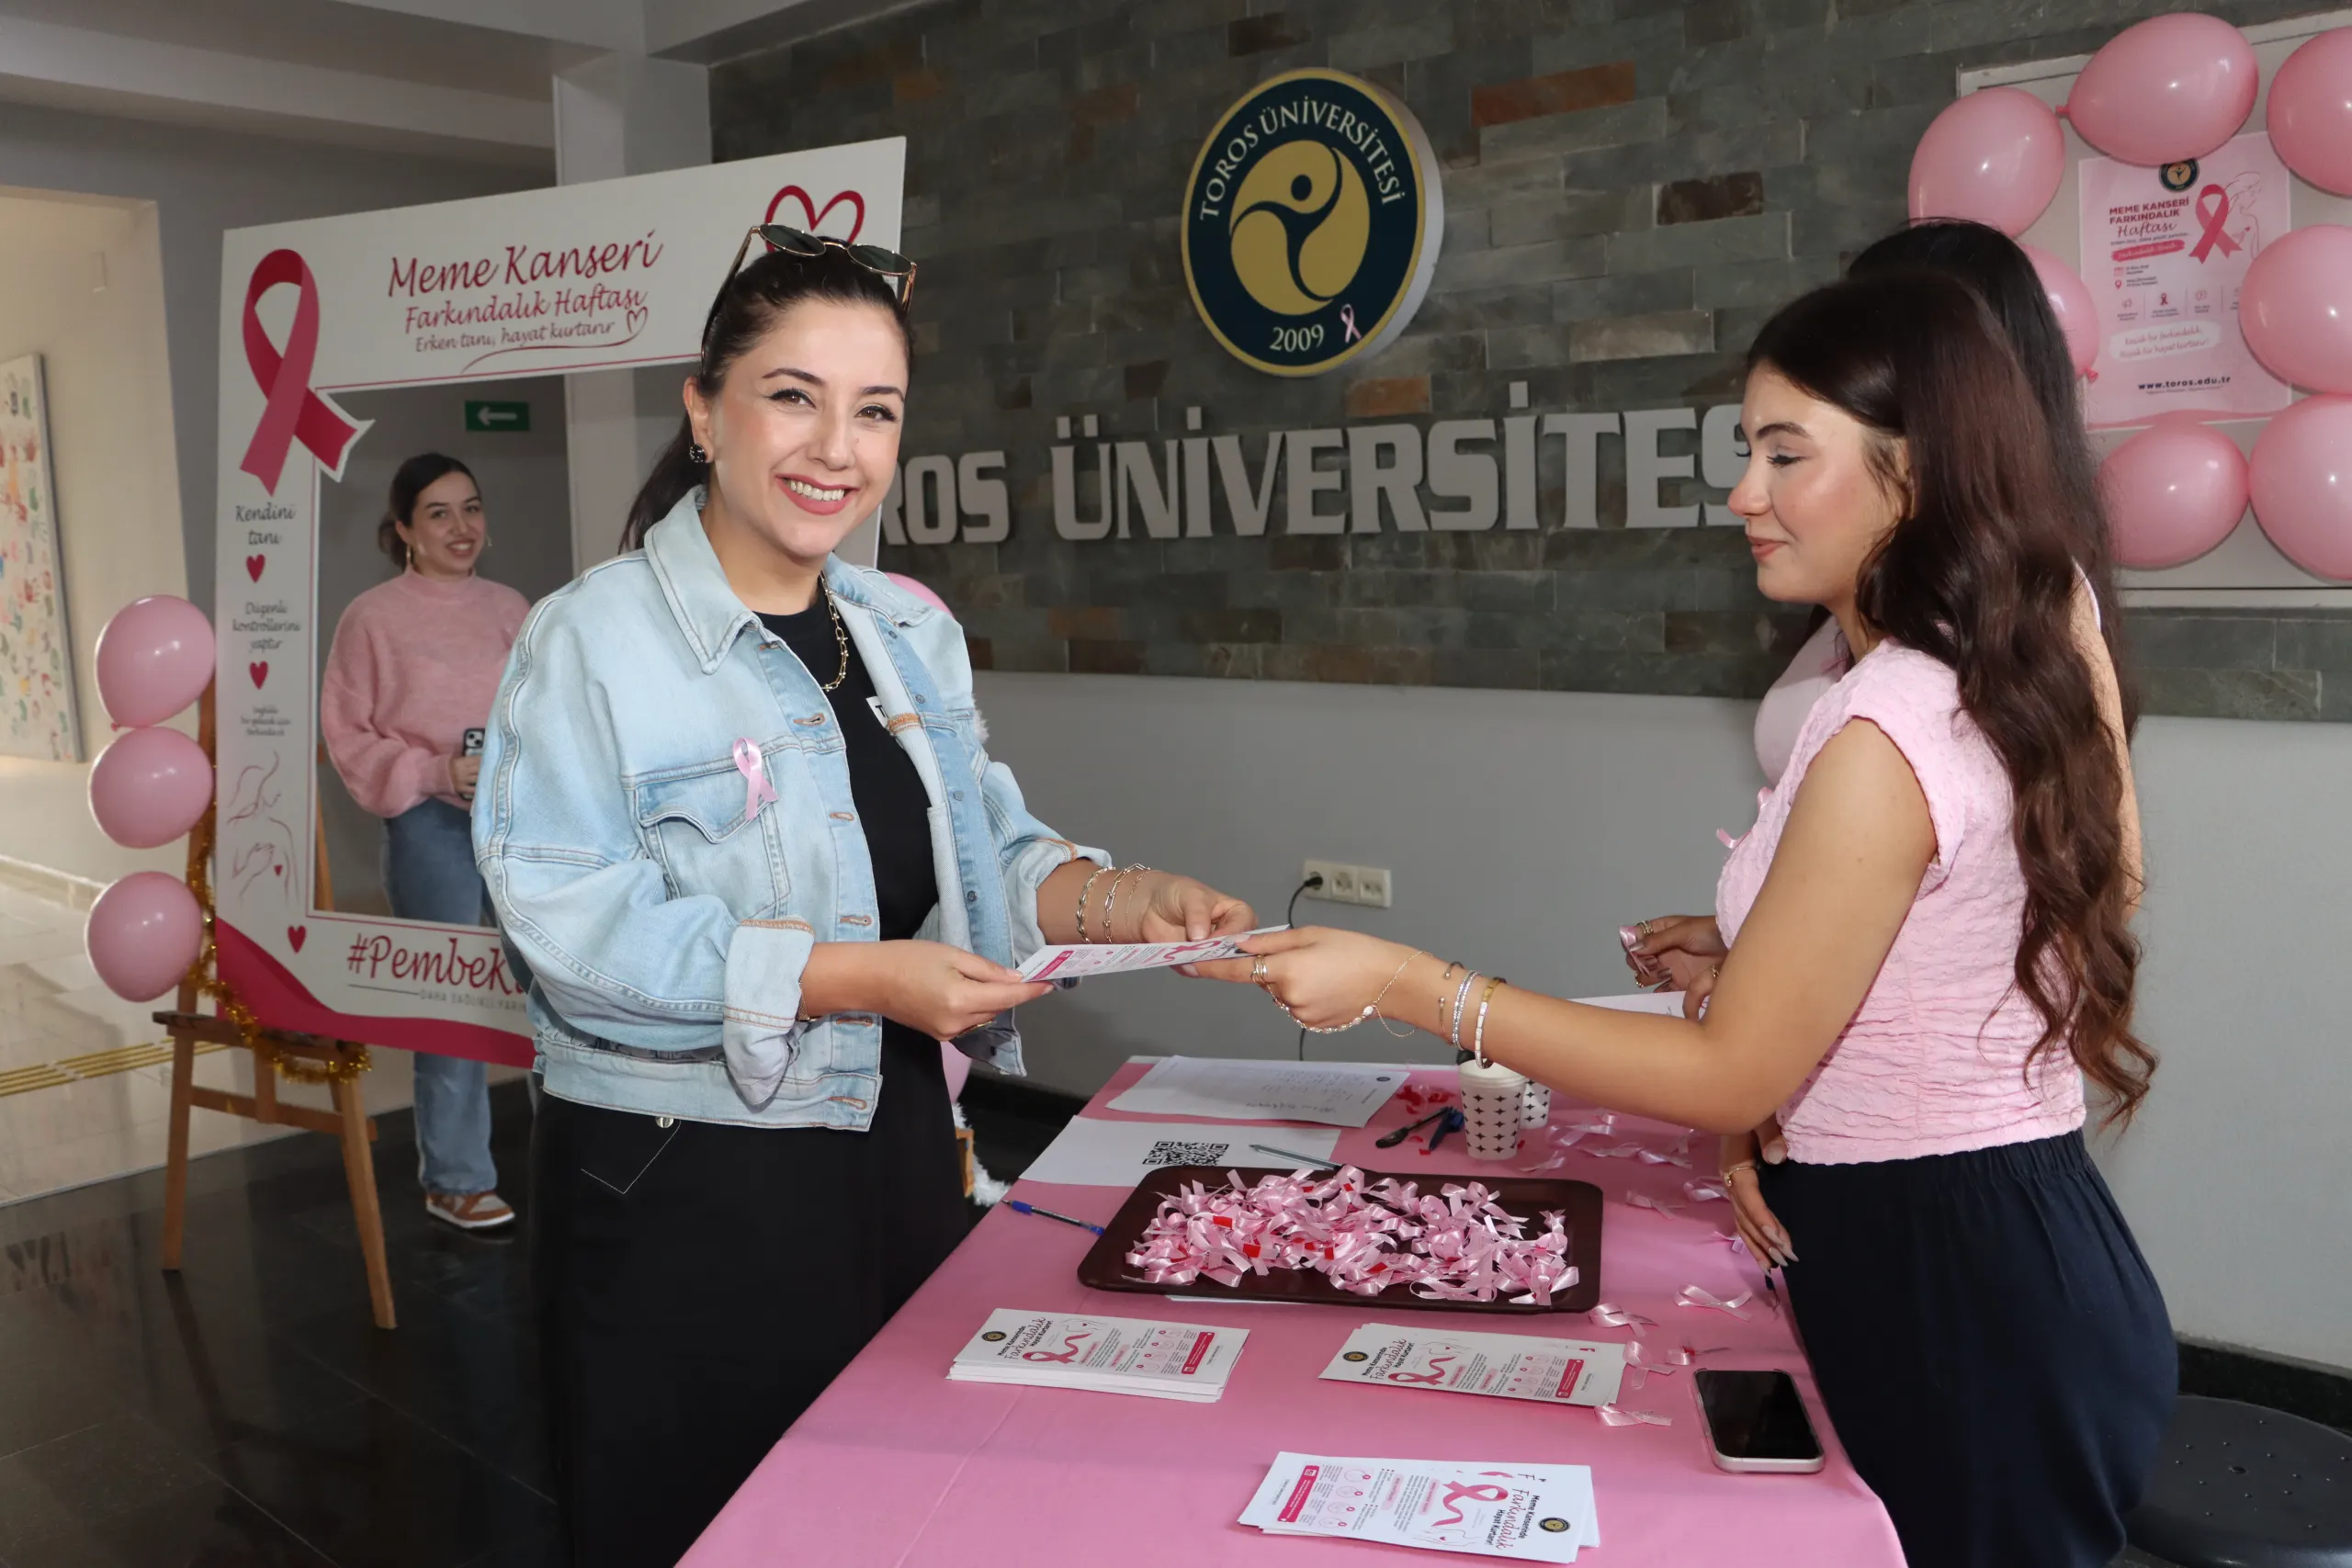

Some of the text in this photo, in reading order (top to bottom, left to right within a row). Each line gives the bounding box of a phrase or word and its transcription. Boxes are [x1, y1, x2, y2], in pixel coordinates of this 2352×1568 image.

[1200, 95, 1407, 220] TOROS ÜNİVERSİTESİ
[2109, 196, 2189, 216] MEME KANSERİ
[2109, 209, 2180, 224] FARKINDALIK
[389, 229, 663, 298] Meme Kanseri
[405, 283, 649, 334] Farkındalık Haftası
[415, 335, 458, 353] Erken
[501, 324, 548, 347] hayat
[1269, 323, 1326, 353] 2009
[2138, 376, 2232, 390] www.toros.edu.tr
[235, 502, 297, 523] Kendini
[248, 529, 281, 546] tanı
[1493, 1509, 1506, 1524] Hayat
[1496, 1488, 1530, 1550] Farkındalık
[1518, 1495, 1540, 1539] Meme Kanserinde
